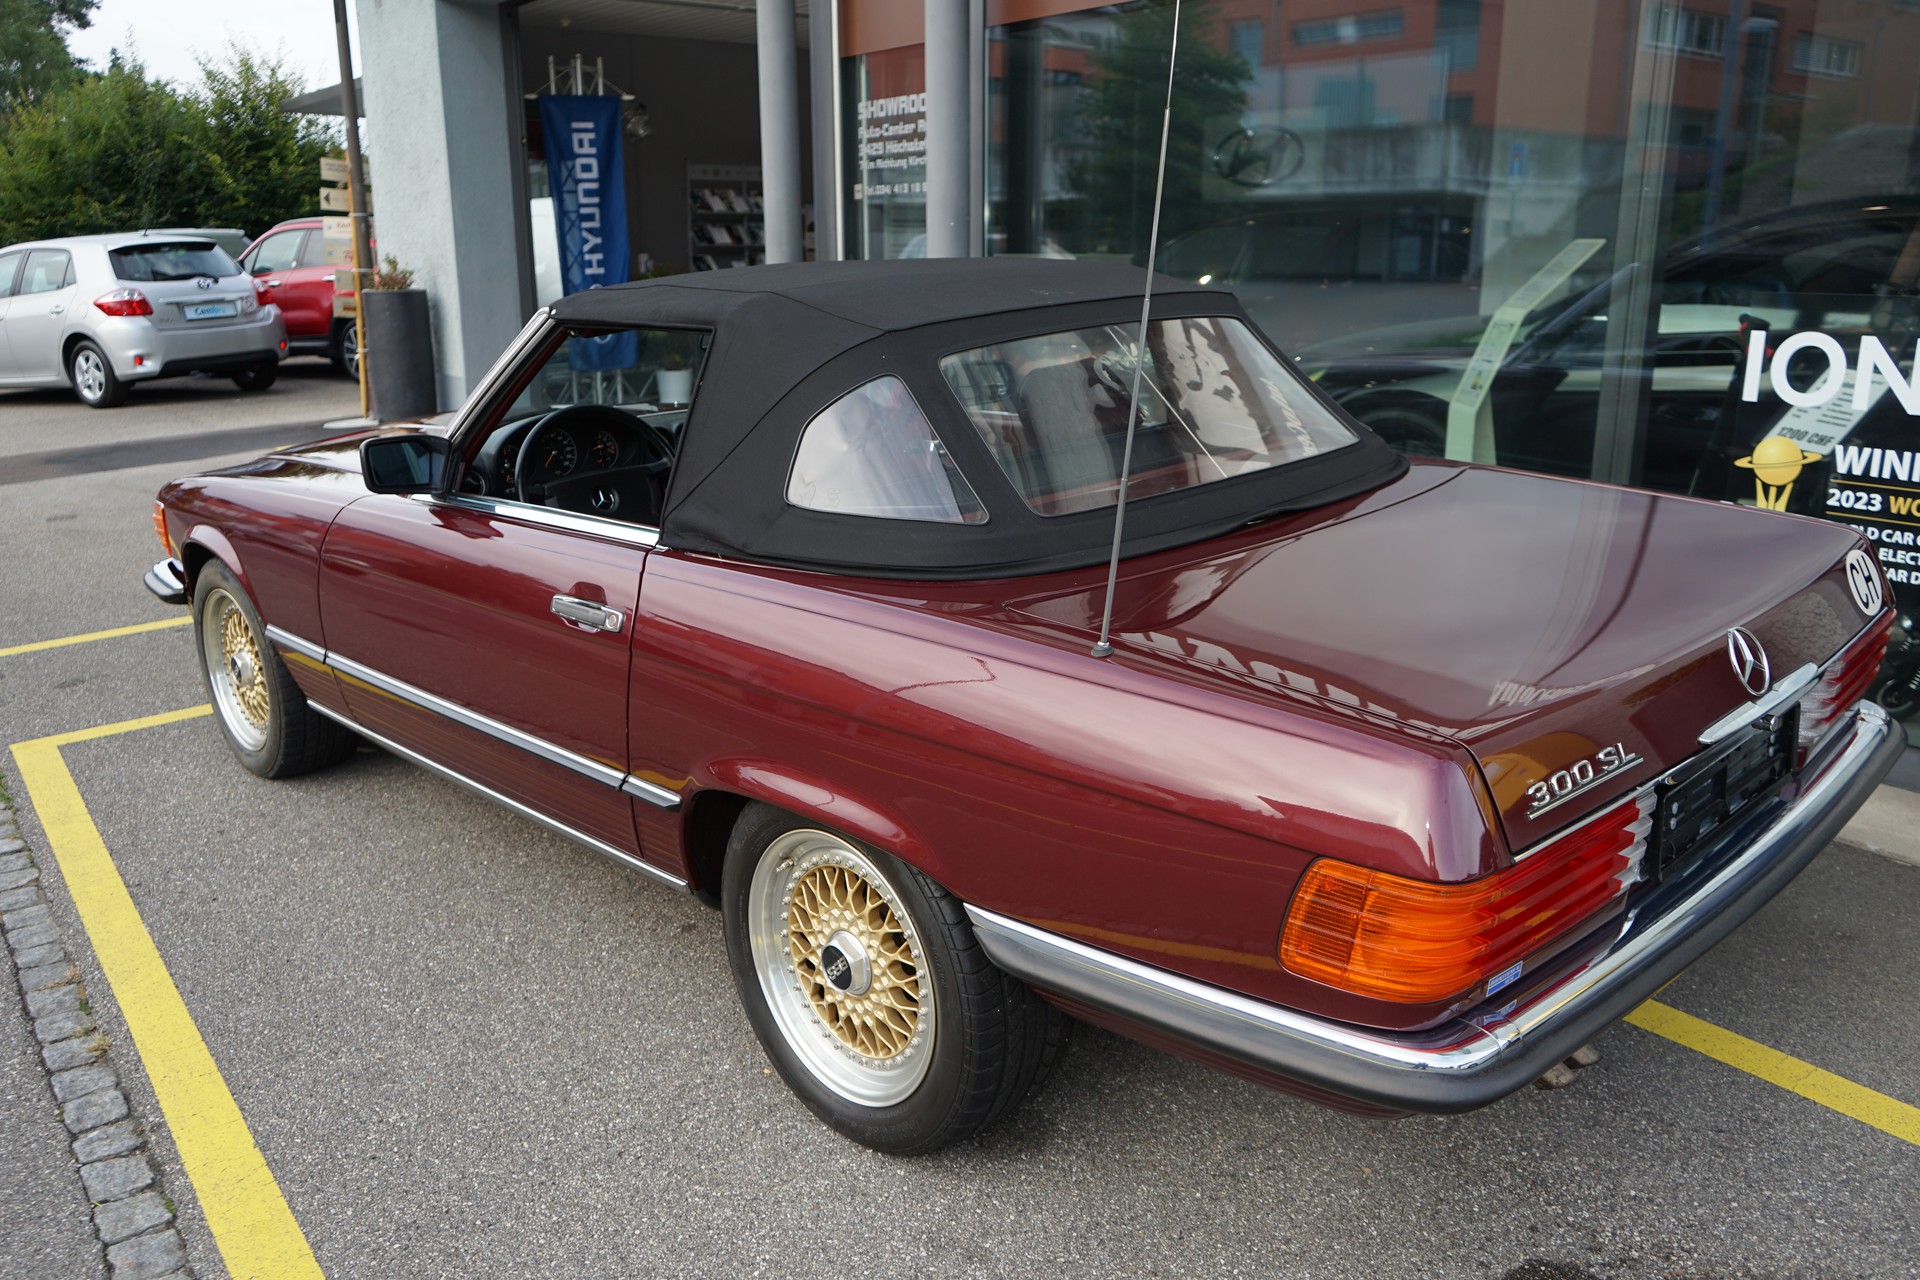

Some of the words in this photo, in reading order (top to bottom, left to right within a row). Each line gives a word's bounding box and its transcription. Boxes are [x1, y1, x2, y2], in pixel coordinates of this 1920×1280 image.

[570, 121, 605, 275] HYUNDAI
[1742, 330, 1920, 416] ION
[1807, 432, 1836, 448] CHF
[1826, 488, 1882, 512] 2023
[1881, 529, 1914, 546] CAR
[1849, 554, 1880, 609] CH
[1883, 566, 1909, 584] AR
[1525, 759, 1594, 808] 300
[1595, 742, 1637, 772] SL
